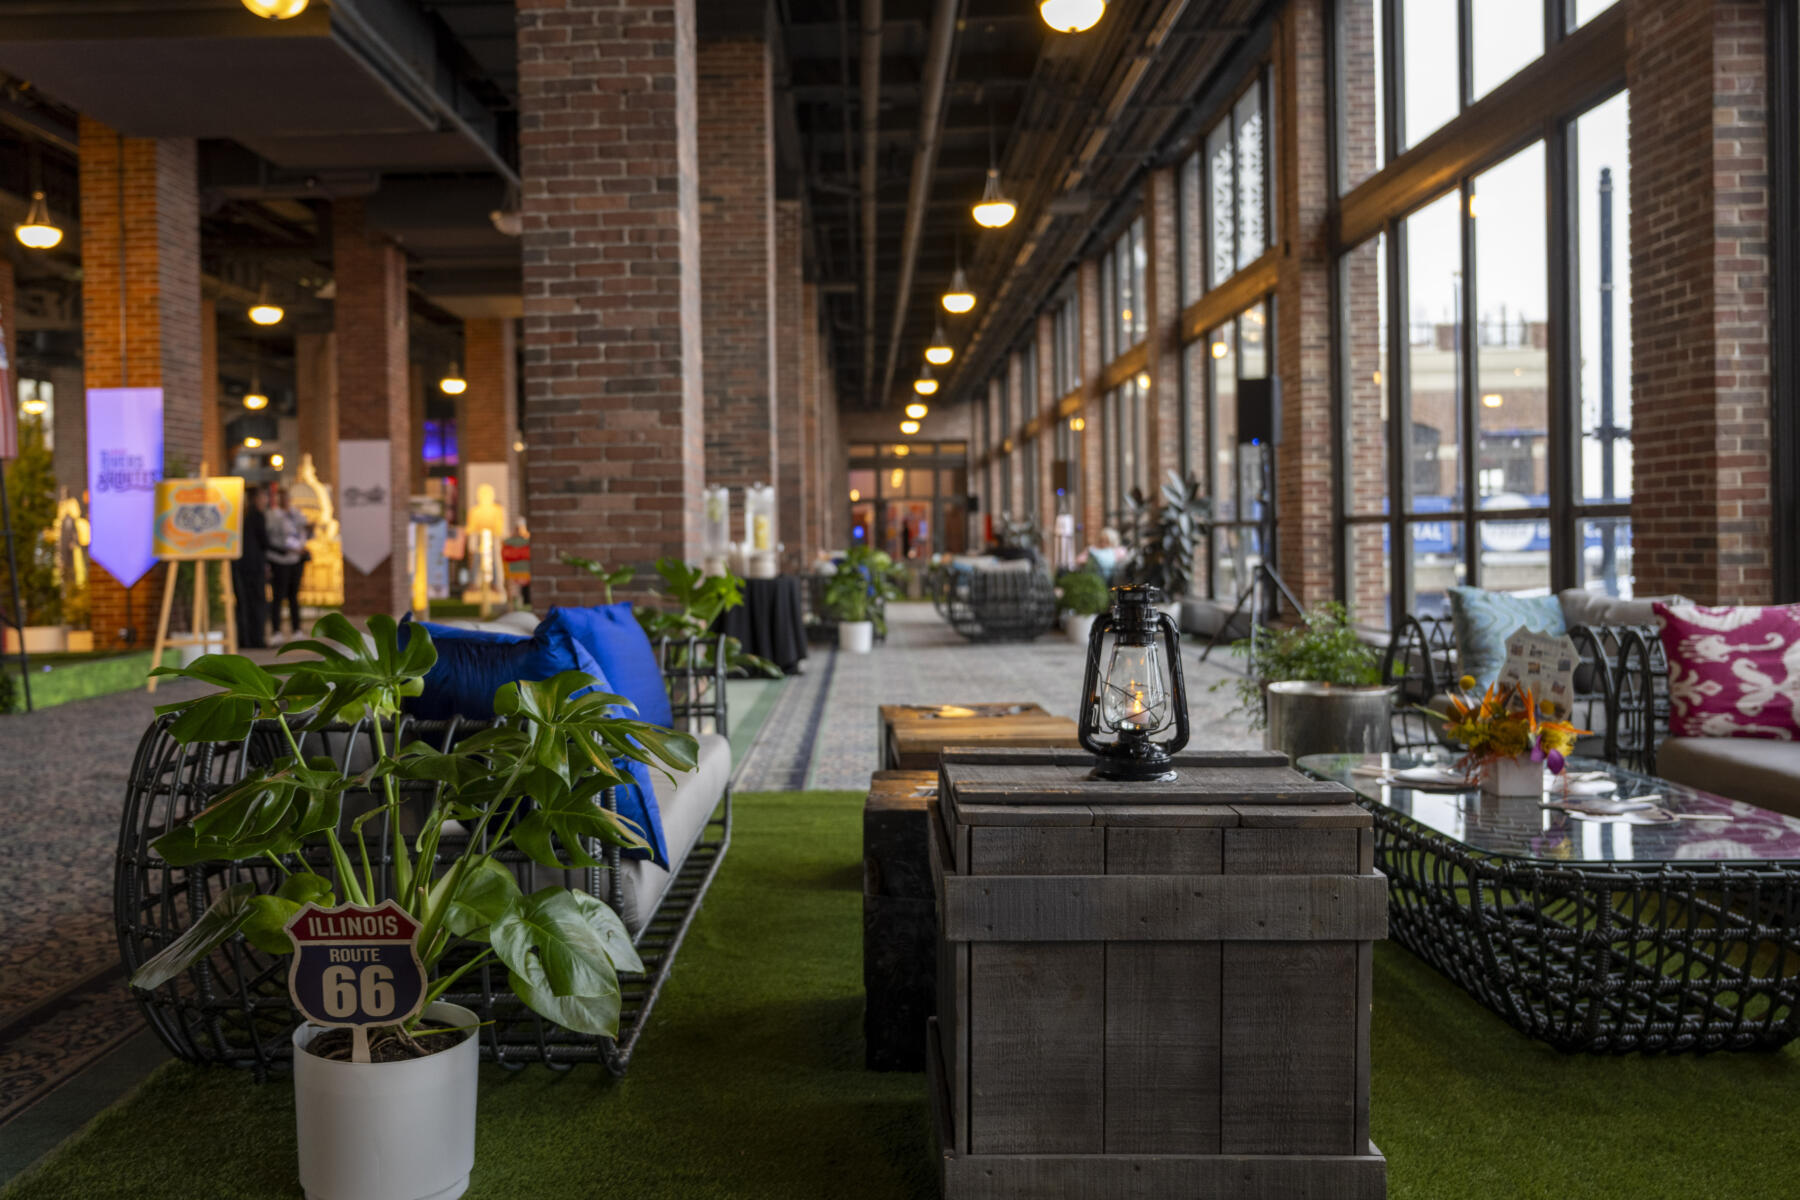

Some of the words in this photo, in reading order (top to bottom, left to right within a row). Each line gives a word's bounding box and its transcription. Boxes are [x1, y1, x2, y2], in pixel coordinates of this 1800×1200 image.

[308, 915, 399, 937] ILLINOIS
[329, 948, 381, 963] ROUTE
[322, 964, 396, 1018] 66
